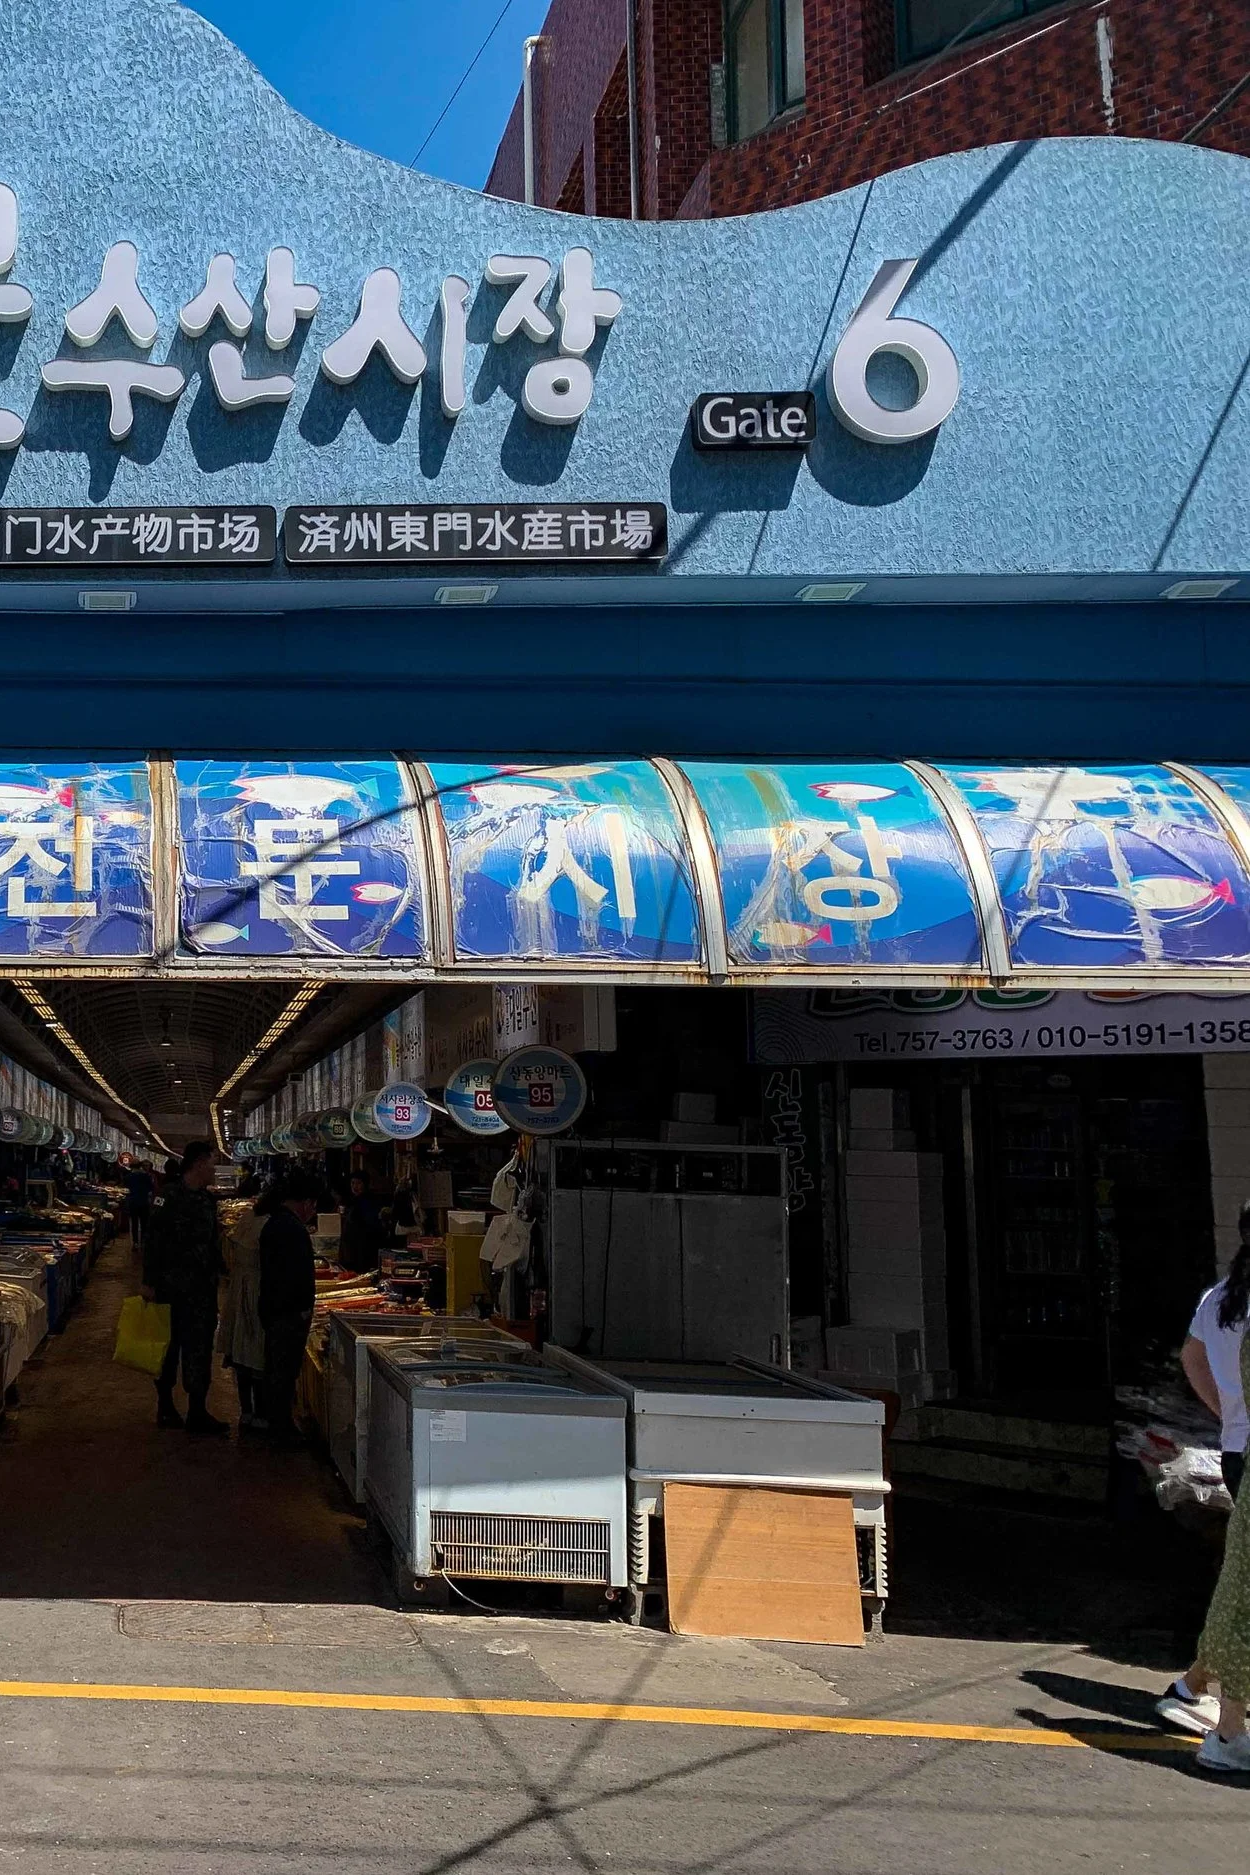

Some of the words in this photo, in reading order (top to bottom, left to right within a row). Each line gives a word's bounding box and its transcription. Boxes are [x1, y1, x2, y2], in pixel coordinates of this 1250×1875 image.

[702, 397, 807, 439] Gate
[828, 258, 961, 444] 6
[298, 509, 656, 554] 済州東門水産市場
[510, 1065, 572, 1081] 신동양마트
[531, 1087, 551, 1103] 95
[395, 1107, 410, 1119] 93
